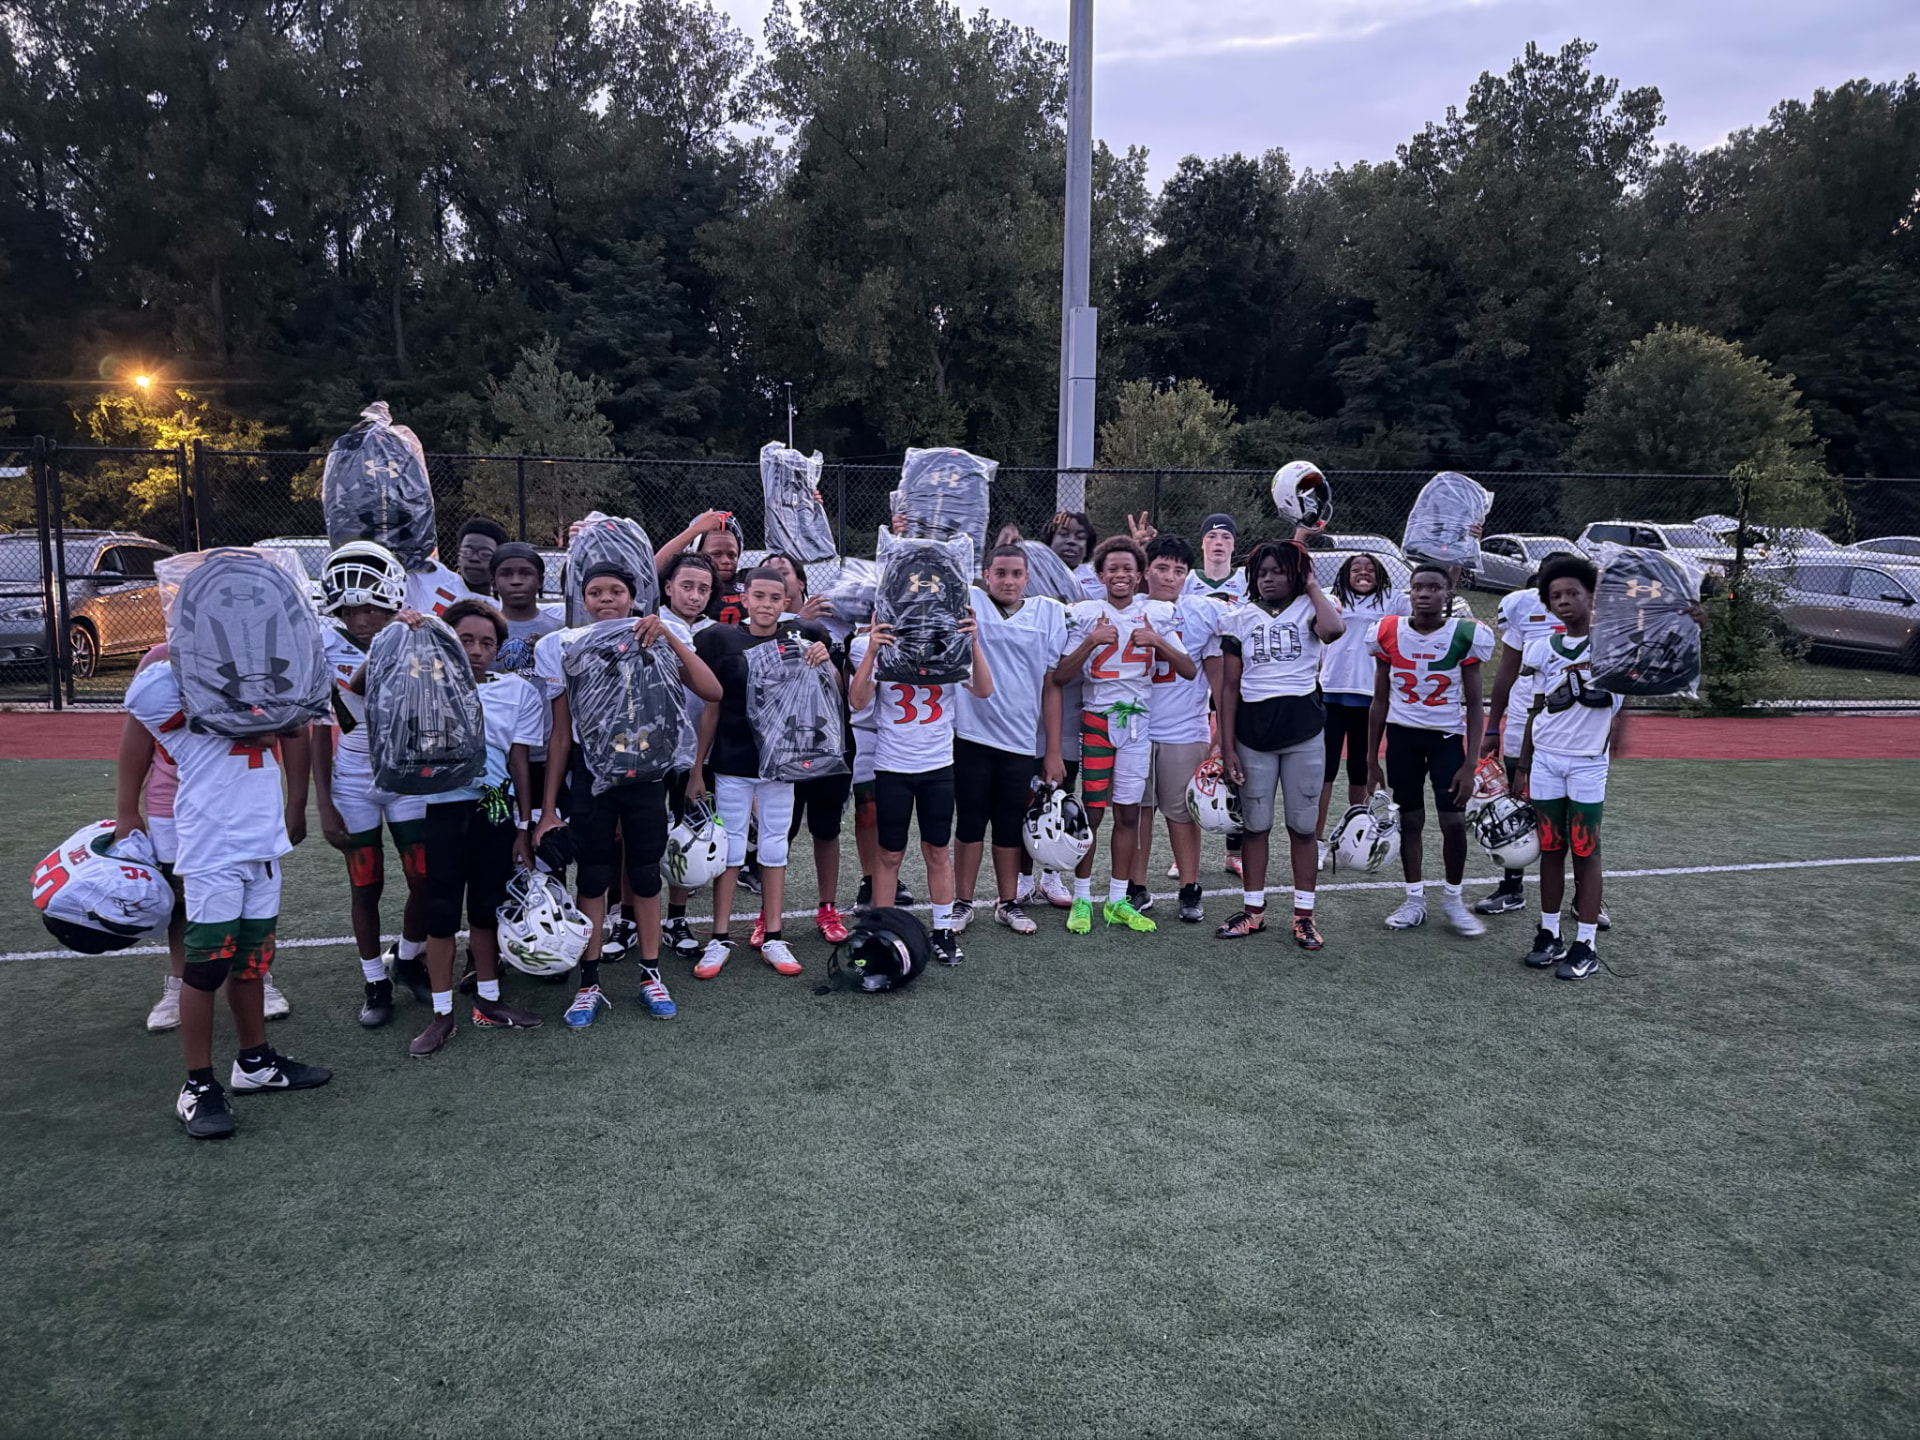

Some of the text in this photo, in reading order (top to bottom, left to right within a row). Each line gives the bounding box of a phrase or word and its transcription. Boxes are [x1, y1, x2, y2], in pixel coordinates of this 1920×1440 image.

[1090, 638, 1153, 679] 24
[1251, 622, 1302, 664] 10
[890, 684, 943, 724] 33
[1393, 671, 1452, 706] 32
